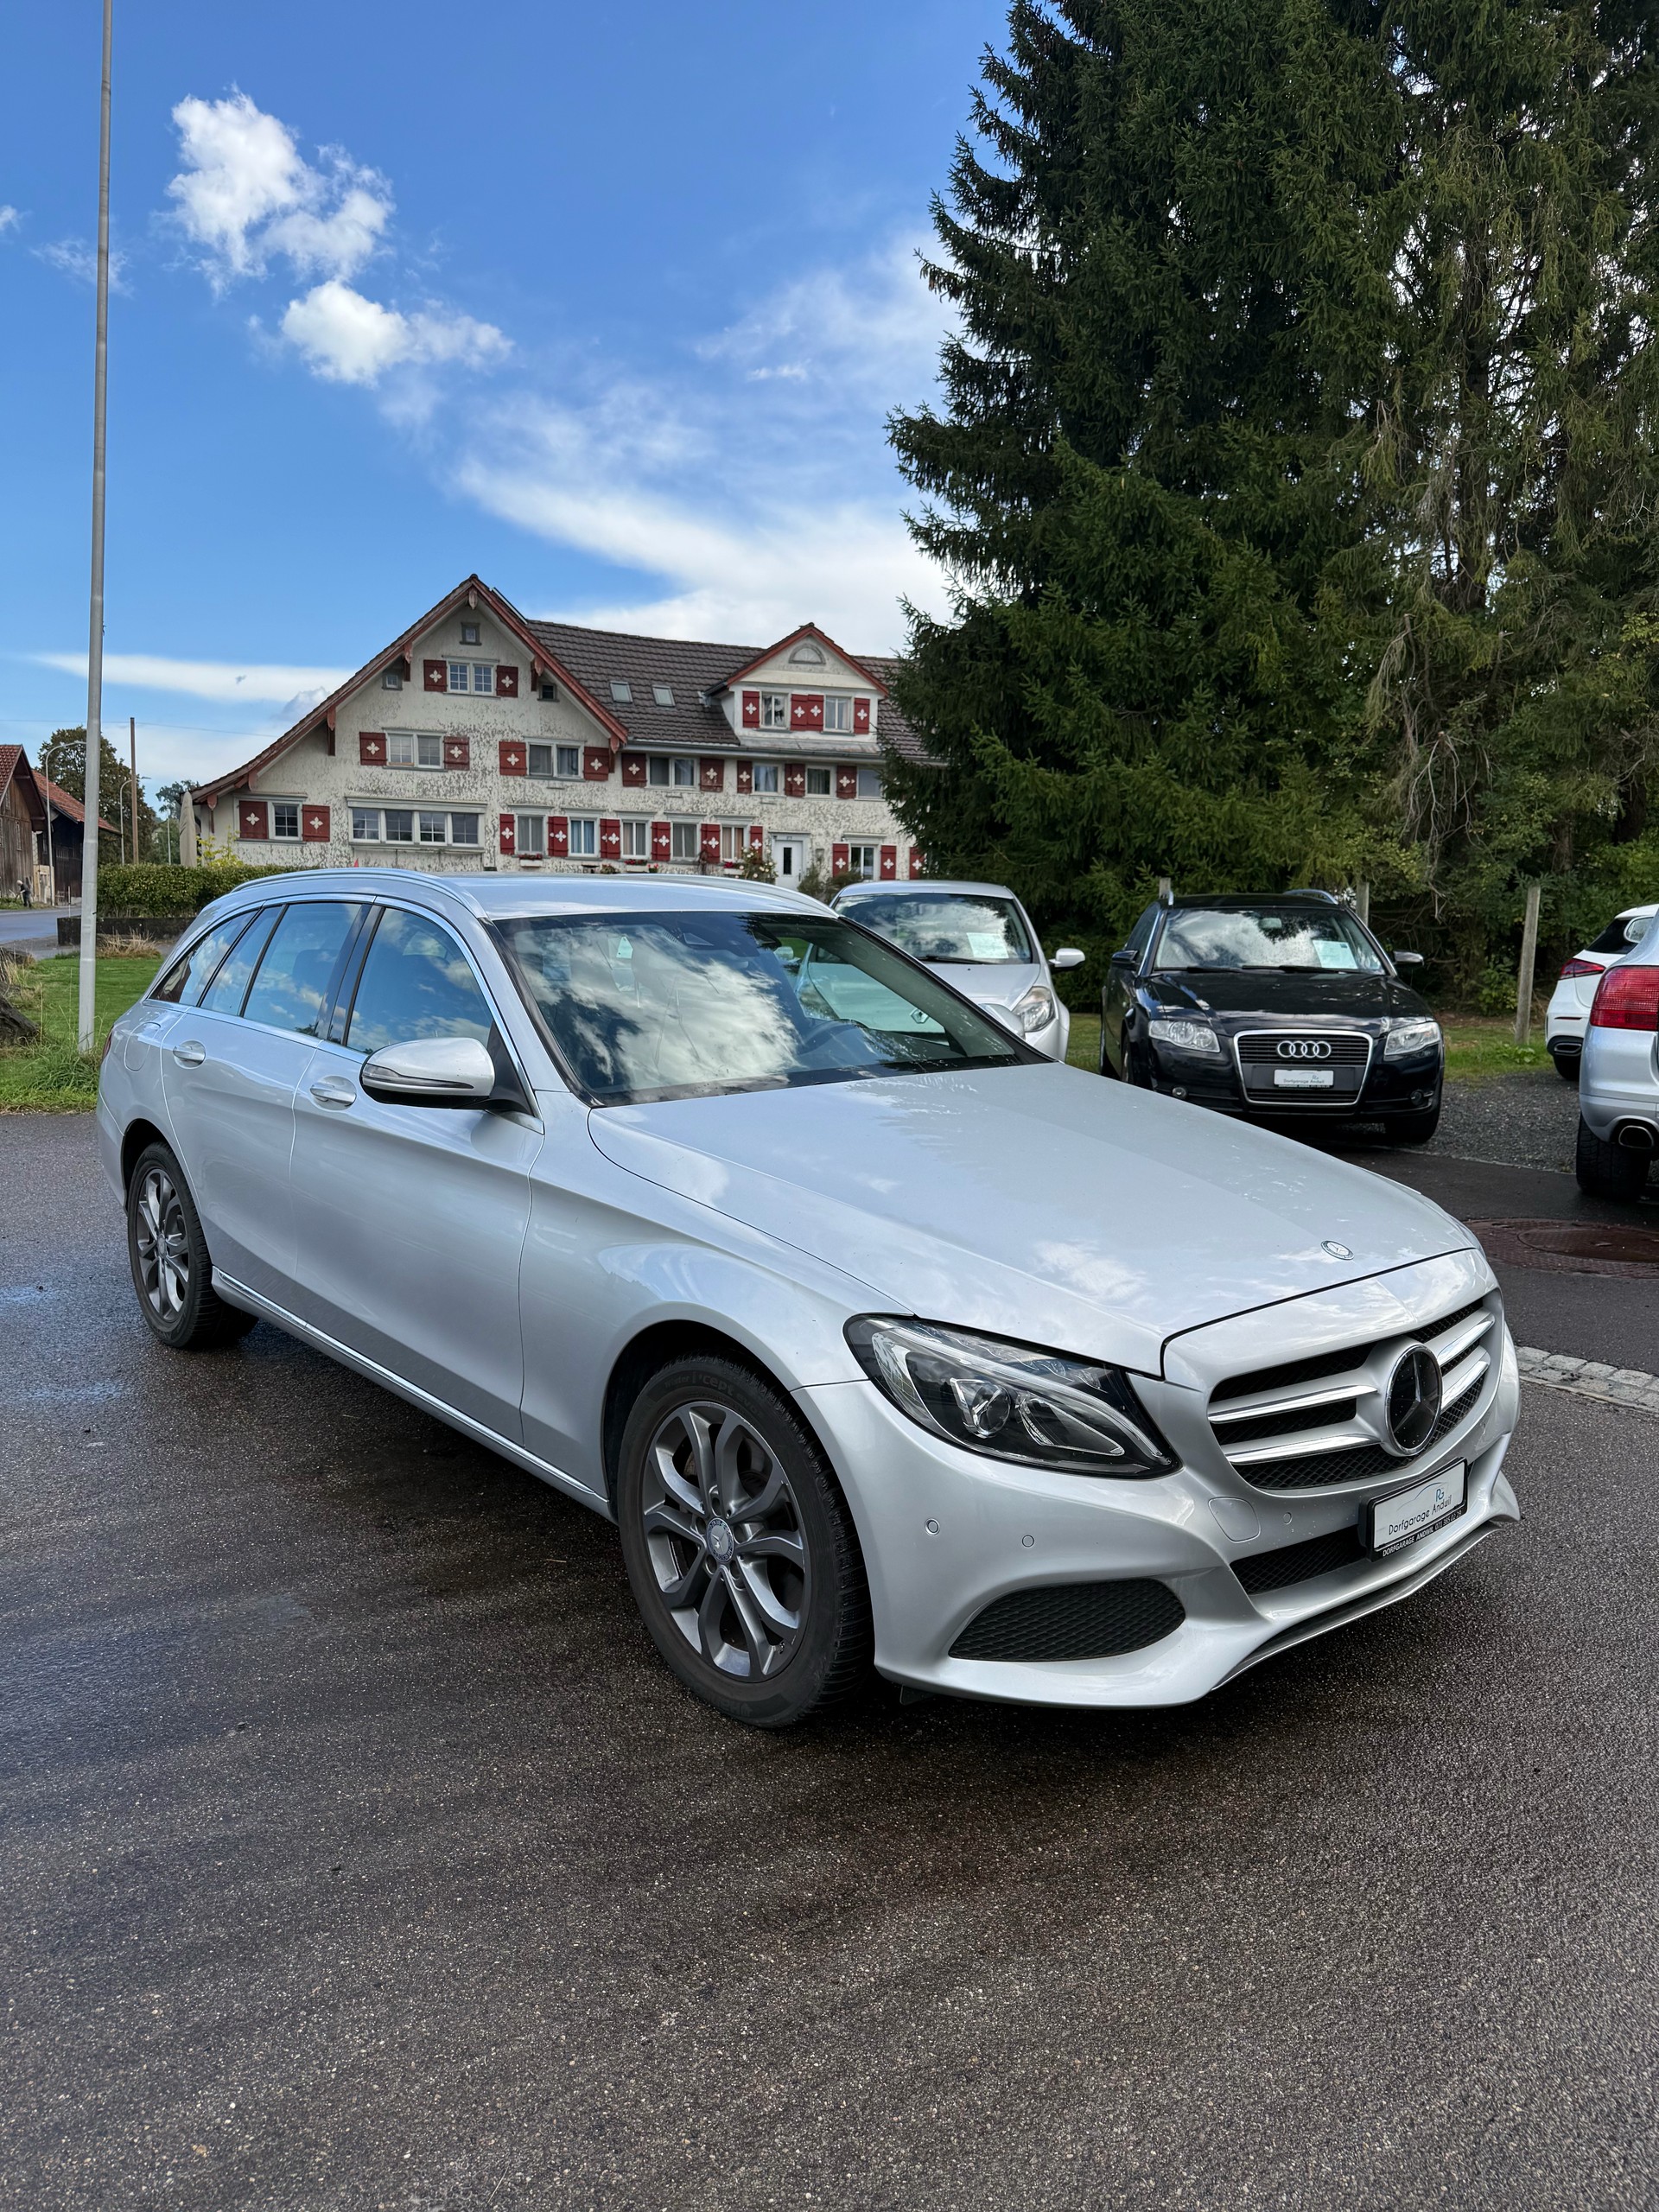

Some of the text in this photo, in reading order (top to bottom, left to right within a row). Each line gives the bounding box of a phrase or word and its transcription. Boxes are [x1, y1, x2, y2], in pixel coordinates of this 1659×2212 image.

[1389, 1494, 1452, 1535] Dorfgarage Andwil
[1382, 1535, 1415, 1557] DORFGARAGE
[1416, 1526, 1433, 1541] ANDWIL
